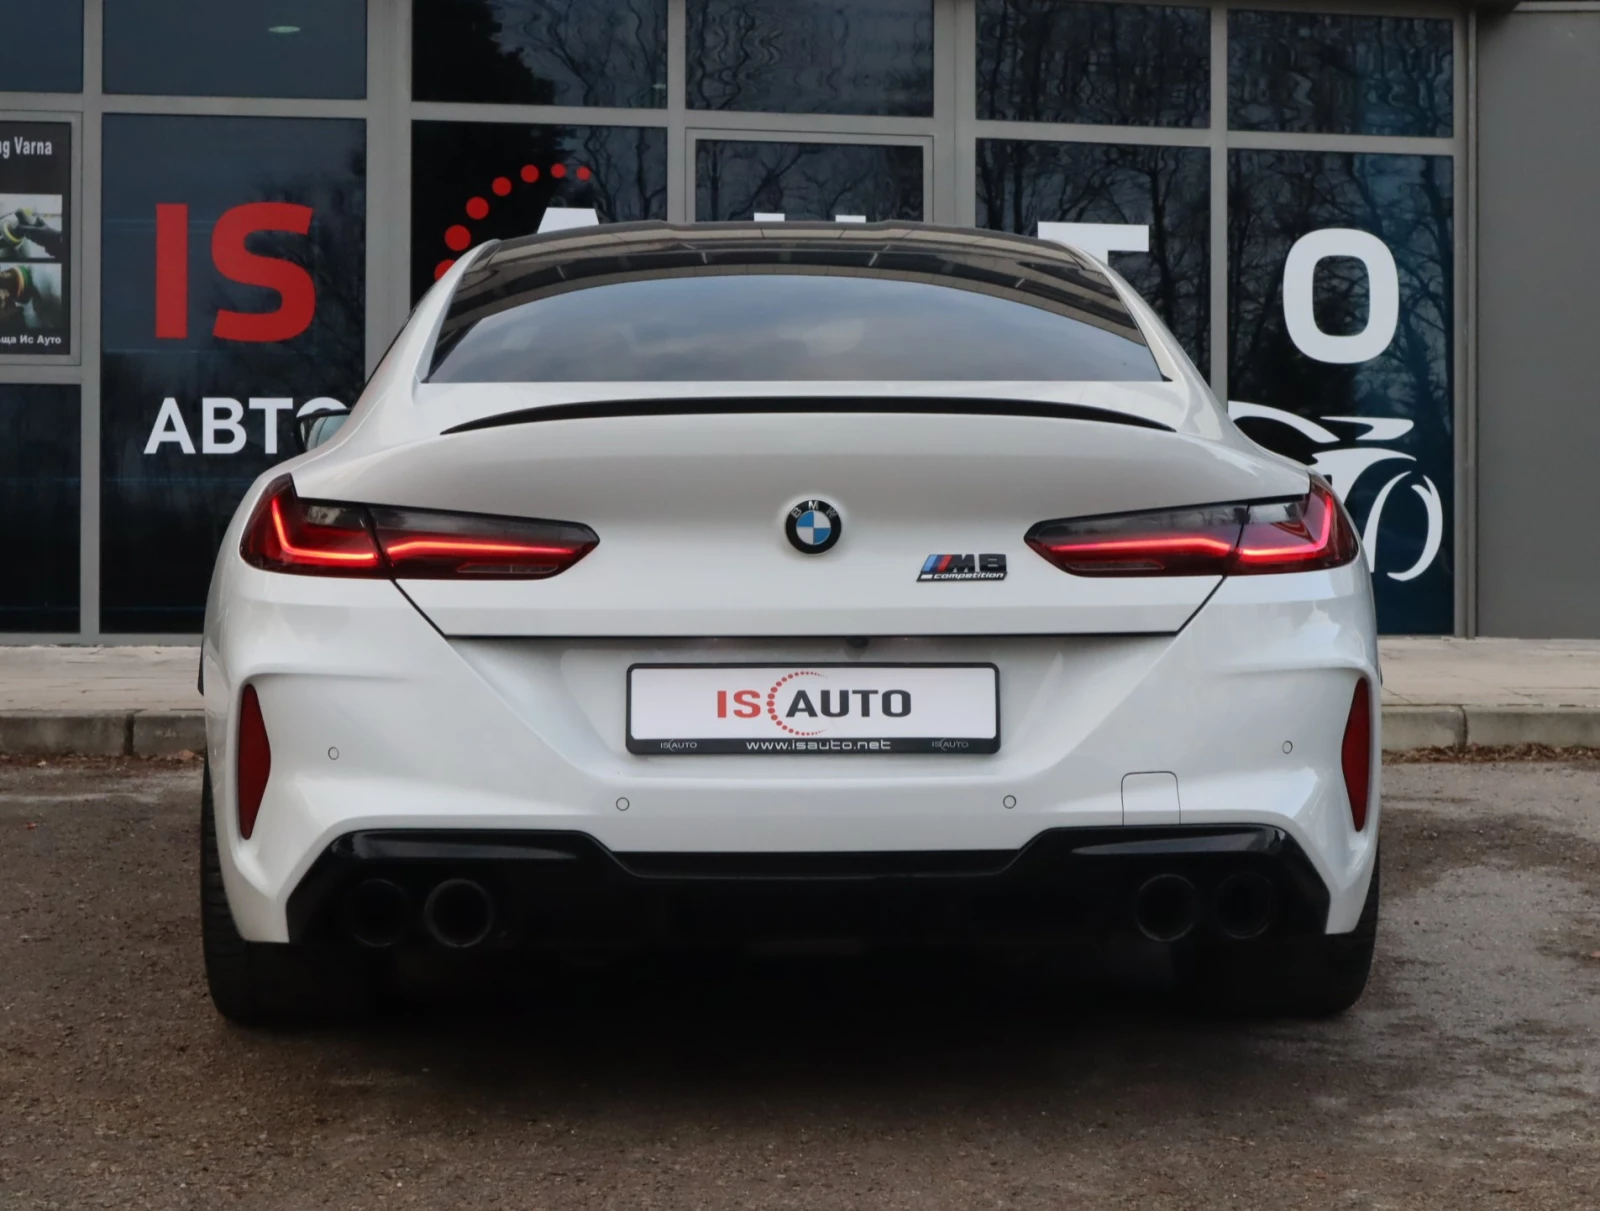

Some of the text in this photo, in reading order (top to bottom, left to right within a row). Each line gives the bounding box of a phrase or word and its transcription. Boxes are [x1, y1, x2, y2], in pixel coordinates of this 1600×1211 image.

[14, 136, 53, 155] Varna
[155, 201, 316, 342] IS
[19, 334, 34, 344] Ис
[36, 334, 62, 346] Ауто
[791, 500, 838, 518] BMW
[946, 553, 1007, 573] M8
[933, 571, 1004, 580] competition
[716, 689, 912, 719] IS AUTO
[746, 739, 891, 751] www.isauto.net
